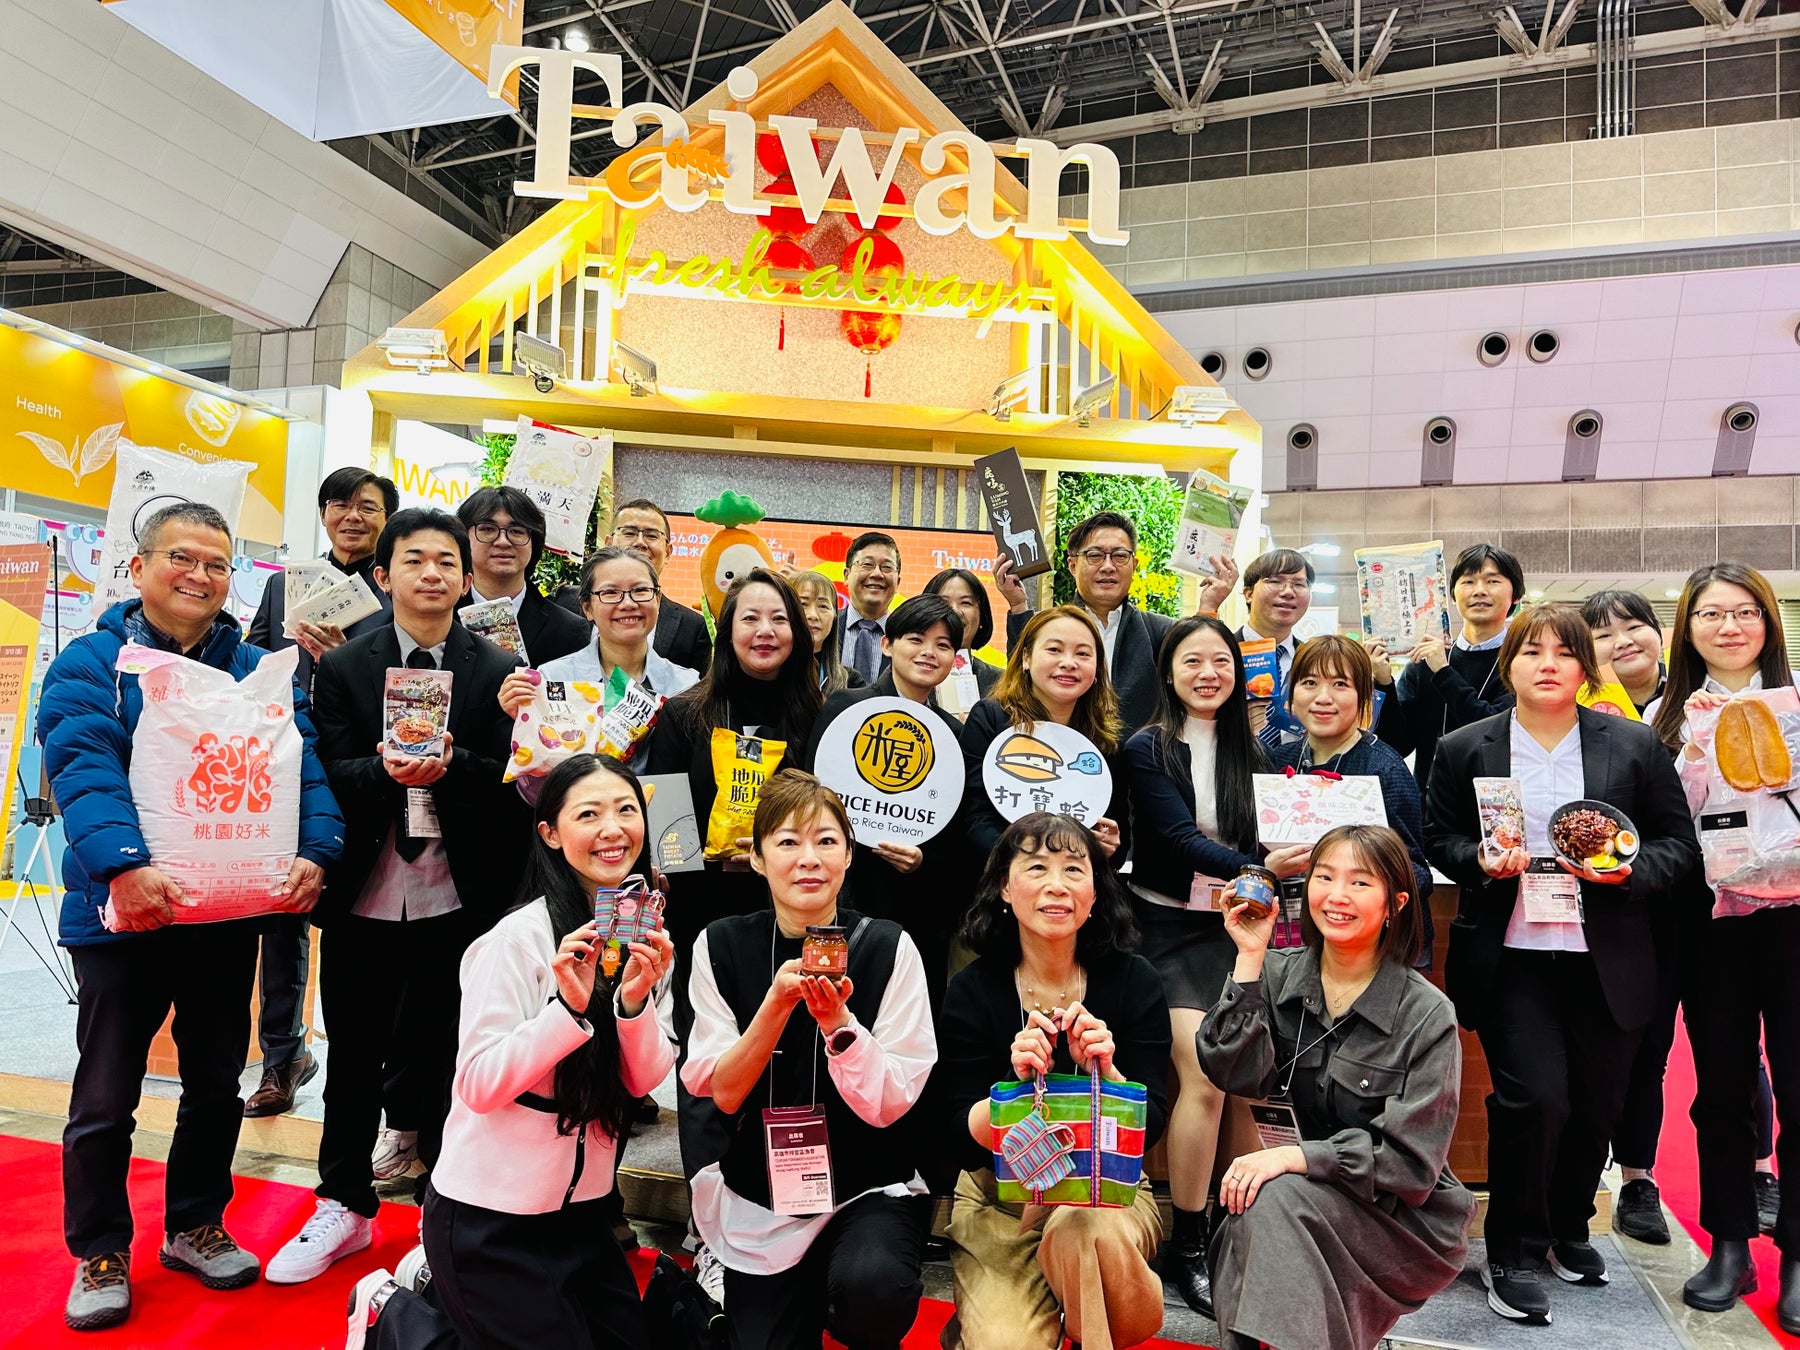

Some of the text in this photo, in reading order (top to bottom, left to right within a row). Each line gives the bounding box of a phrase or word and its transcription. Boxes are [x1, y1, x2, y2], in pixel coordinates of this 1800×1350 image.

[487, 45, 1131, 246] Taiwan
[606, 219, 1033, 337] fresh always
[16, 395, 62, 420] Health
[931, 550, 998, 571] Taiwa
[732, 768, 765, 785] 地瓜
[875, 801, 936, 825] HOUSE
[193, 823, 271, 840] 桃園好米
[862, 817, 884, 830] Rice
[888, 823, 924, 838] Taiwan
